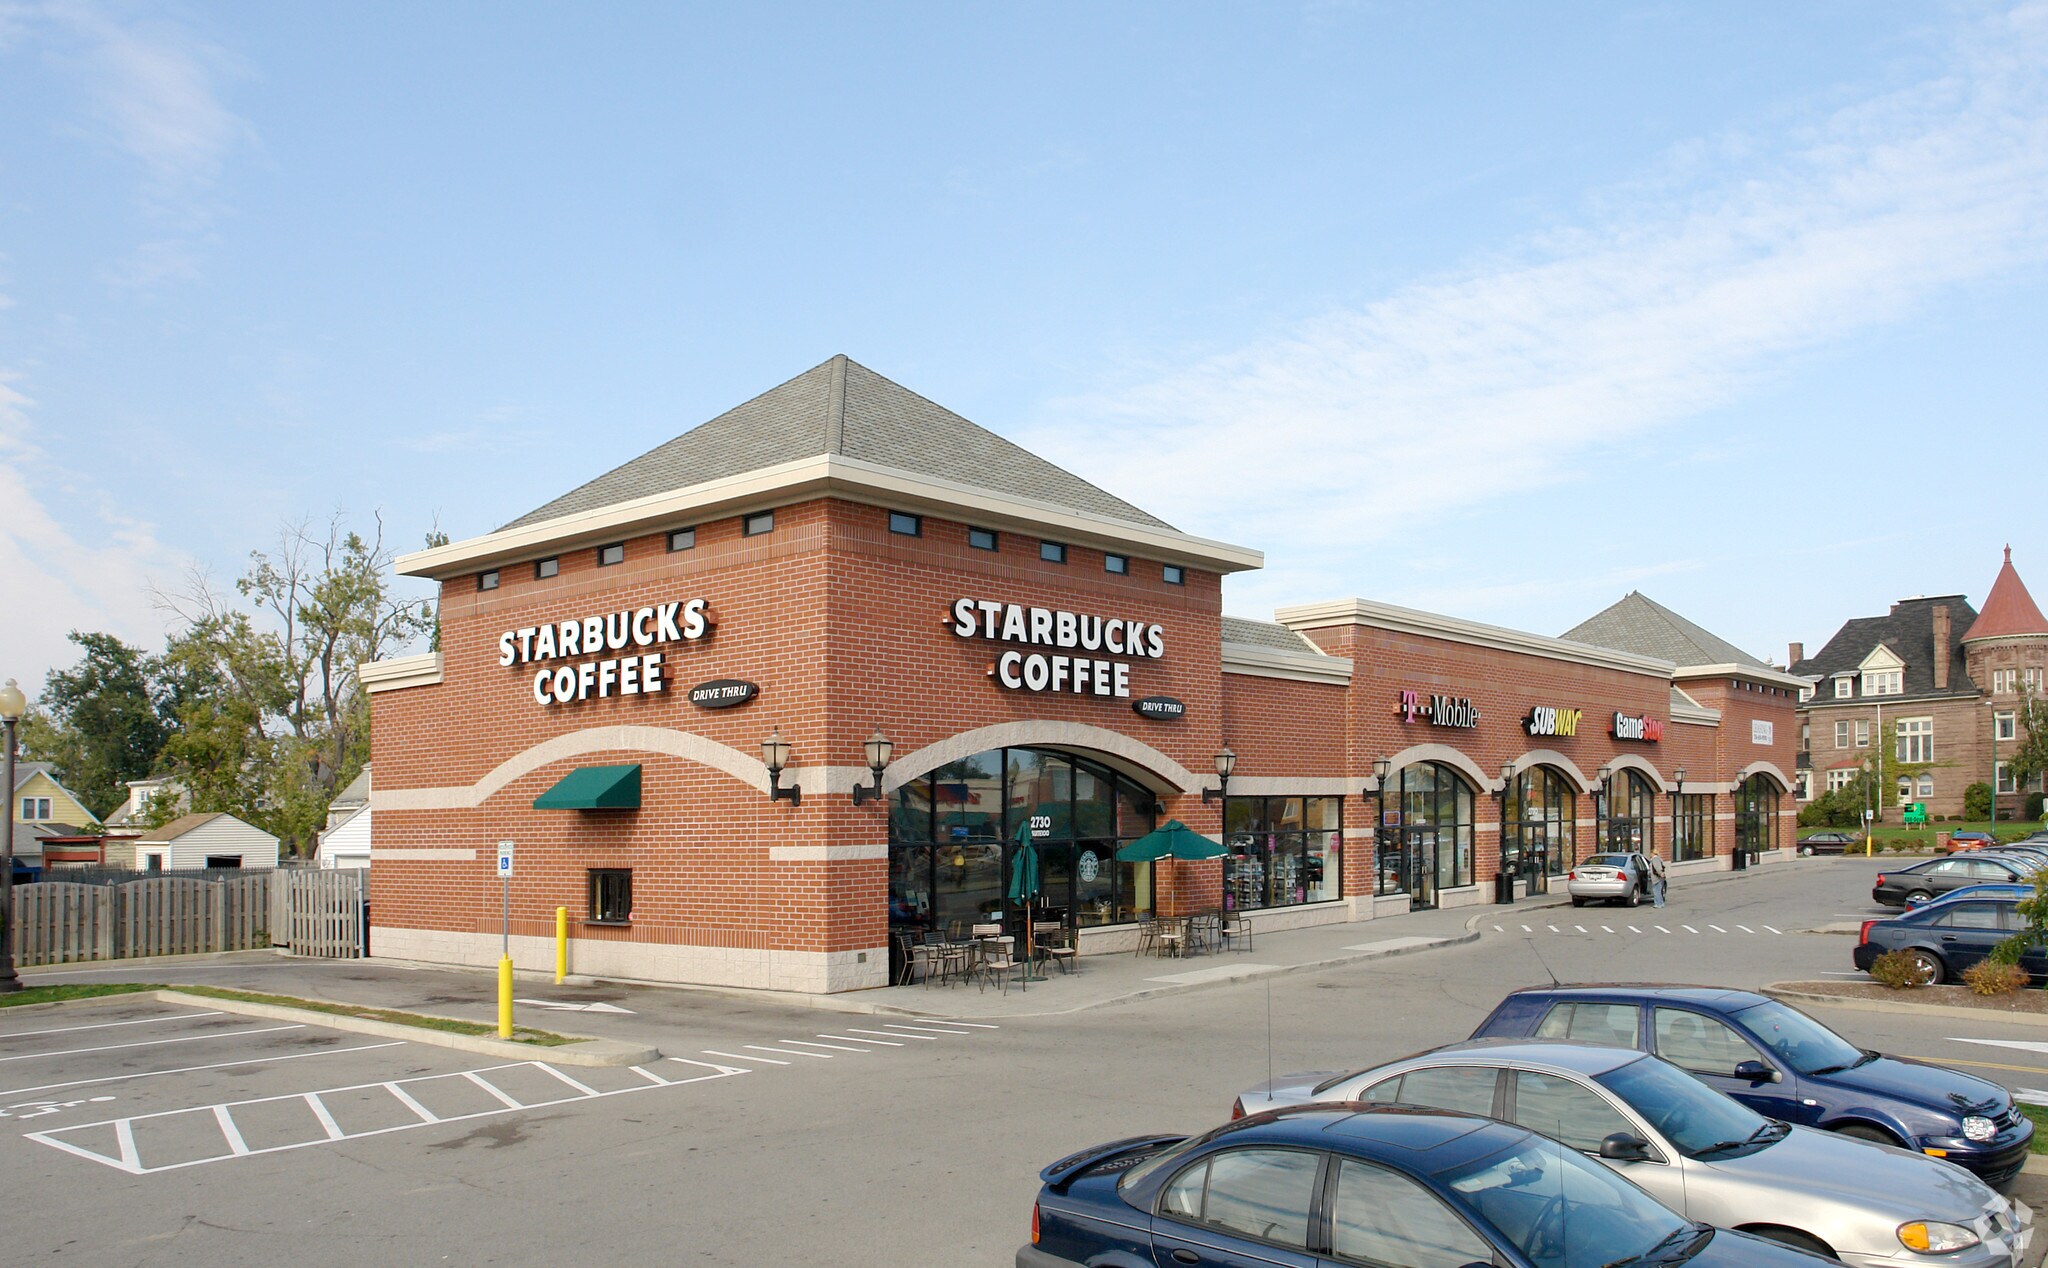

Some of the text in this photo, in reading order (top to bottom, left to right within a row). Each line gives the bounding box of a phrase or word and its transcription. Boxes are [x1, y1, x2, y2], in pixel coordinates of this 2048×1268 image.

[500, 599, 708, 667] STARBUCKS
[954, 598, 1164, 658] STARBUCKS
[533, 653, 663, 705] COFFEE
[998, 651, 1130, 697] COFFEE
[692, 684, 748, 701] DRIVE THRU
[1142, 702, 1182, 713] DRIVE THRU
[1530, 706, 1582, 736] SUBWAY
[1616, 712, 1663, 741] GameStop
[1030, 816, 1051, 828] 2730
